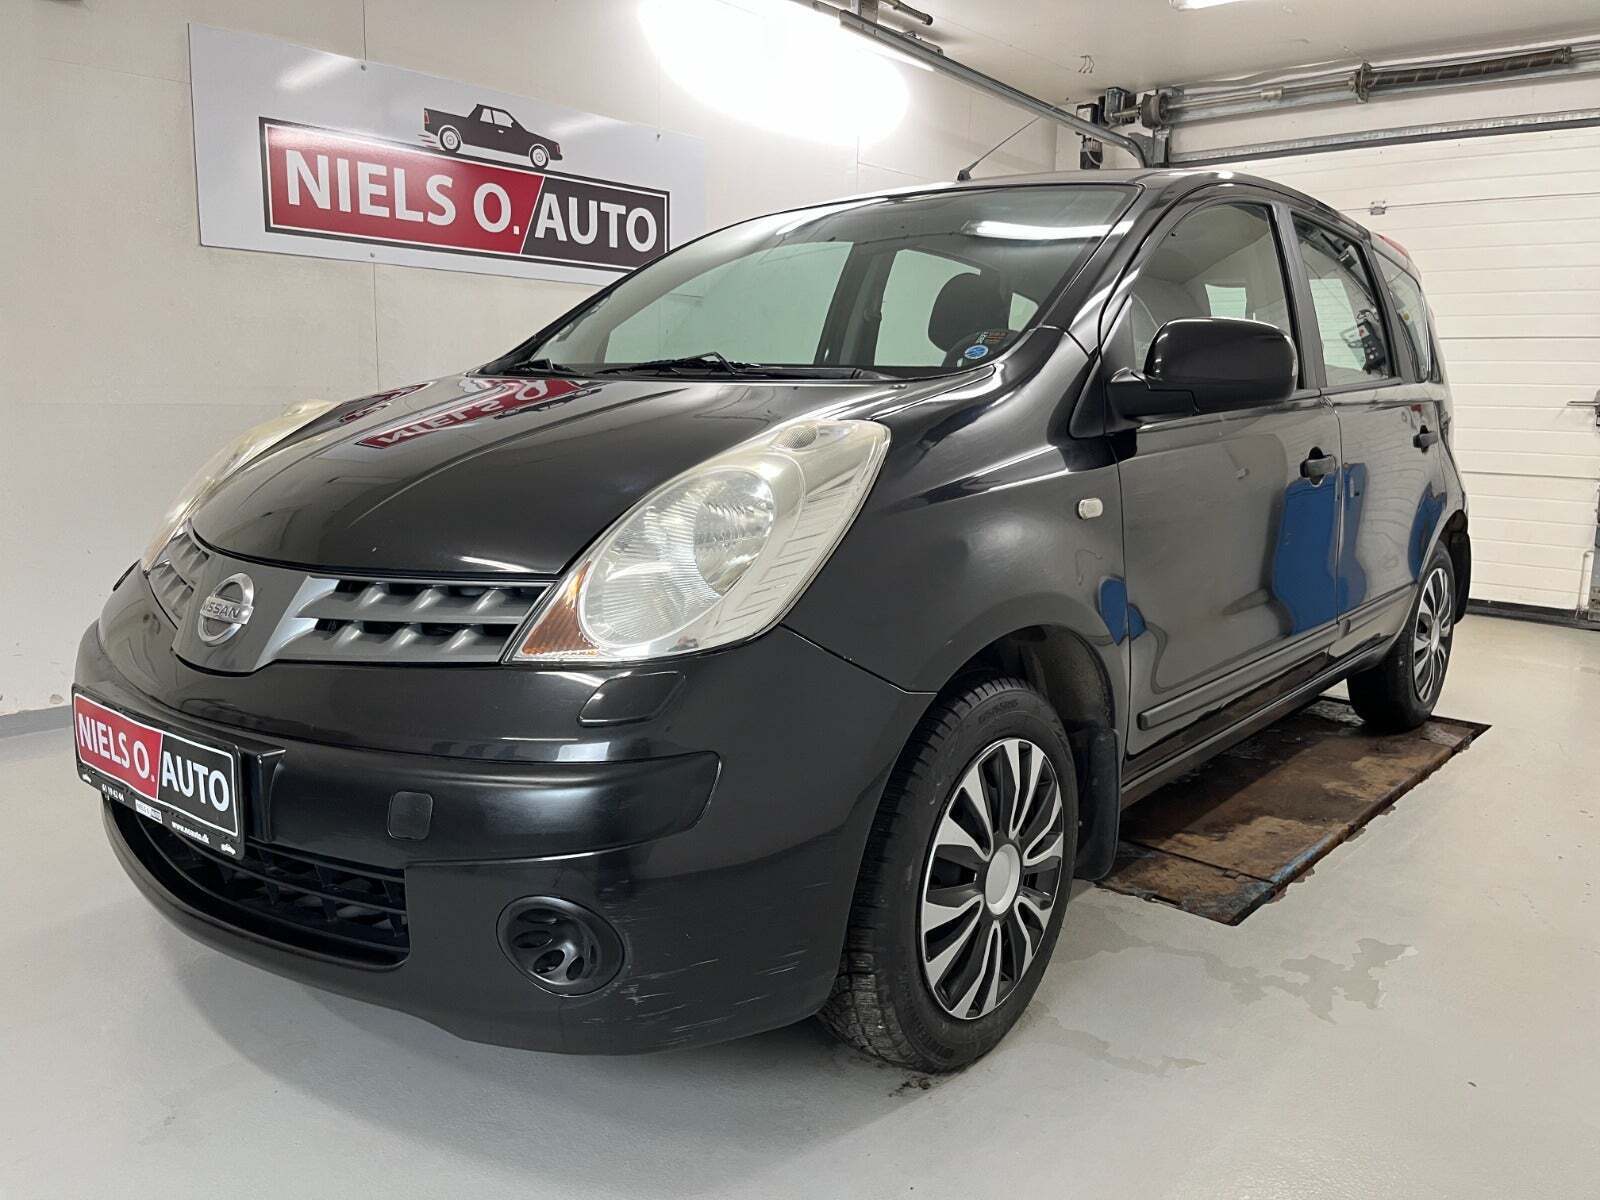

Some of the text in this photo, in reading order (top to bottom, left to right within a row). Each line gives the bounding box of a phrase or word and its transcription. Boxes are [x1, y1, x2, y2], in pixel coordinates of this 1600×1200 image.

[285, 149, 657, 252] NIELS O. AUTO
[78, 713, 230, 812] NIELS O. AUTO
